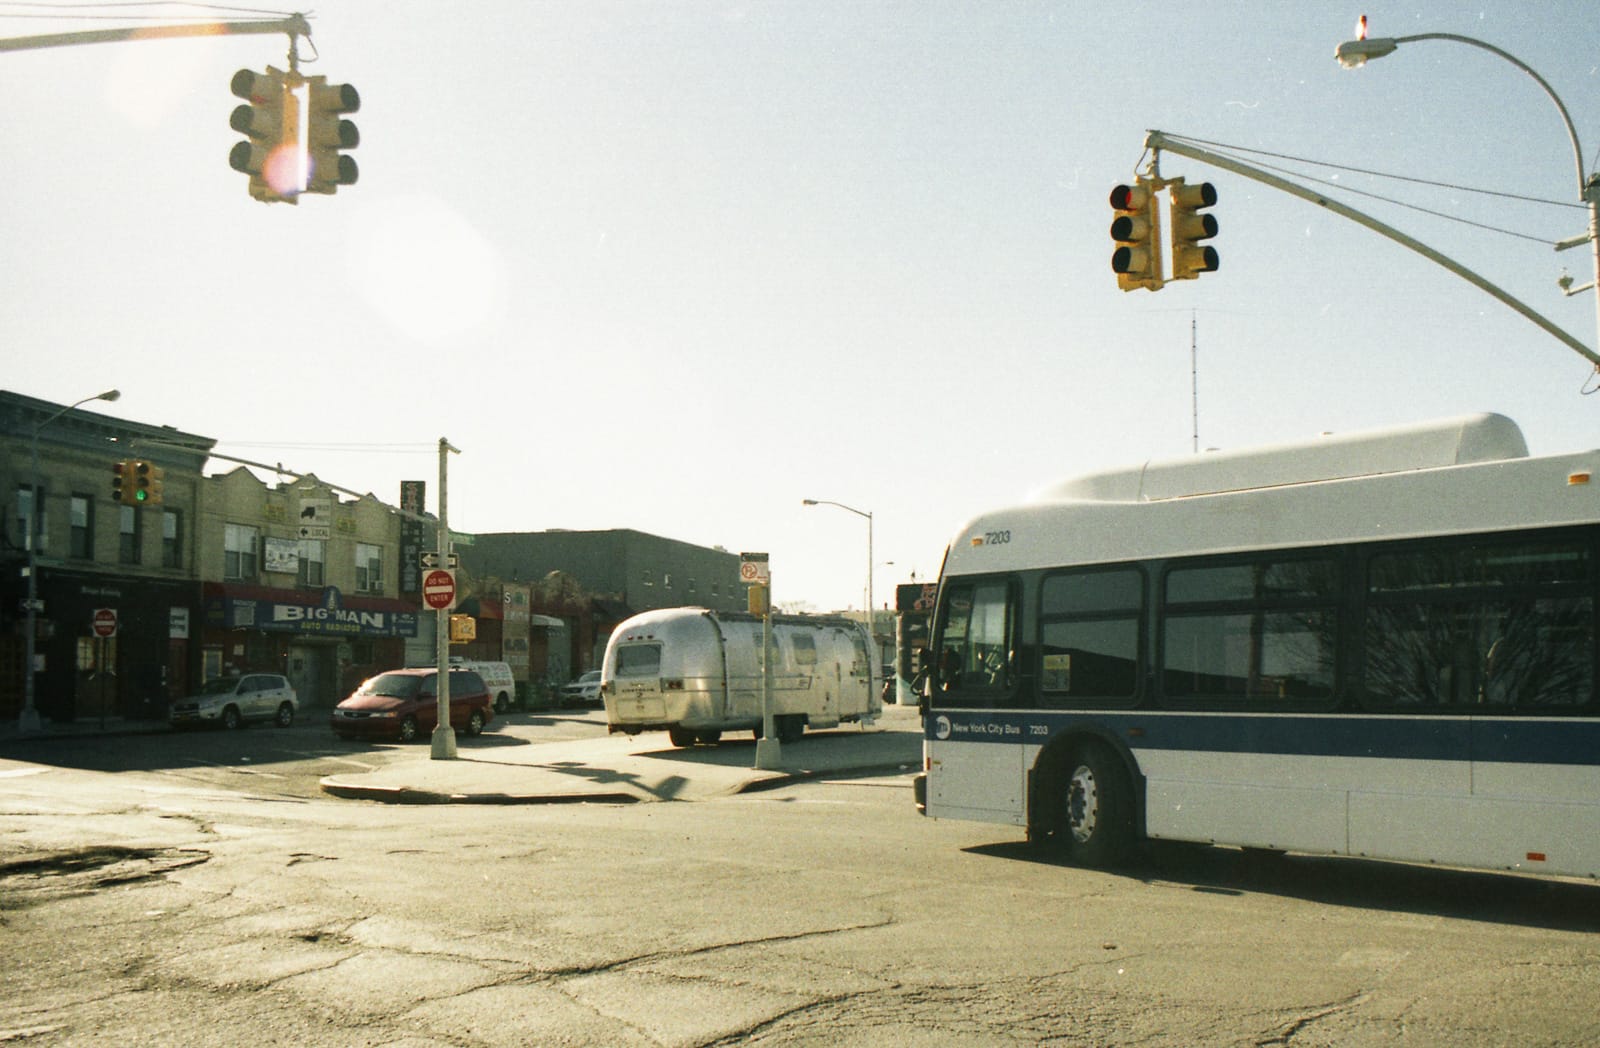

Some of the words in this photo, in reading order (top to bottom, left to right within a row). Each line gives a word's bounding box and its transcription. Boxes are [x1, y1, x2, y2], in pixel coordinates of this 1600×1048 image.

[311, 529, 329, 537] LOCAL
[985, 530, 1011, 545] 7203
[430, 594, 448, 602] ENTER
[273, 604, 329, 621] BIG
[335, 609, 385, 628] MAN
[952, 723, 969, 732] New
[970, 723, 987, 734] York
[987, 723, 1003, 736] City
[1005, 724, 1020, 734] Bus
[1029, 725, 1049, 735] 7203
